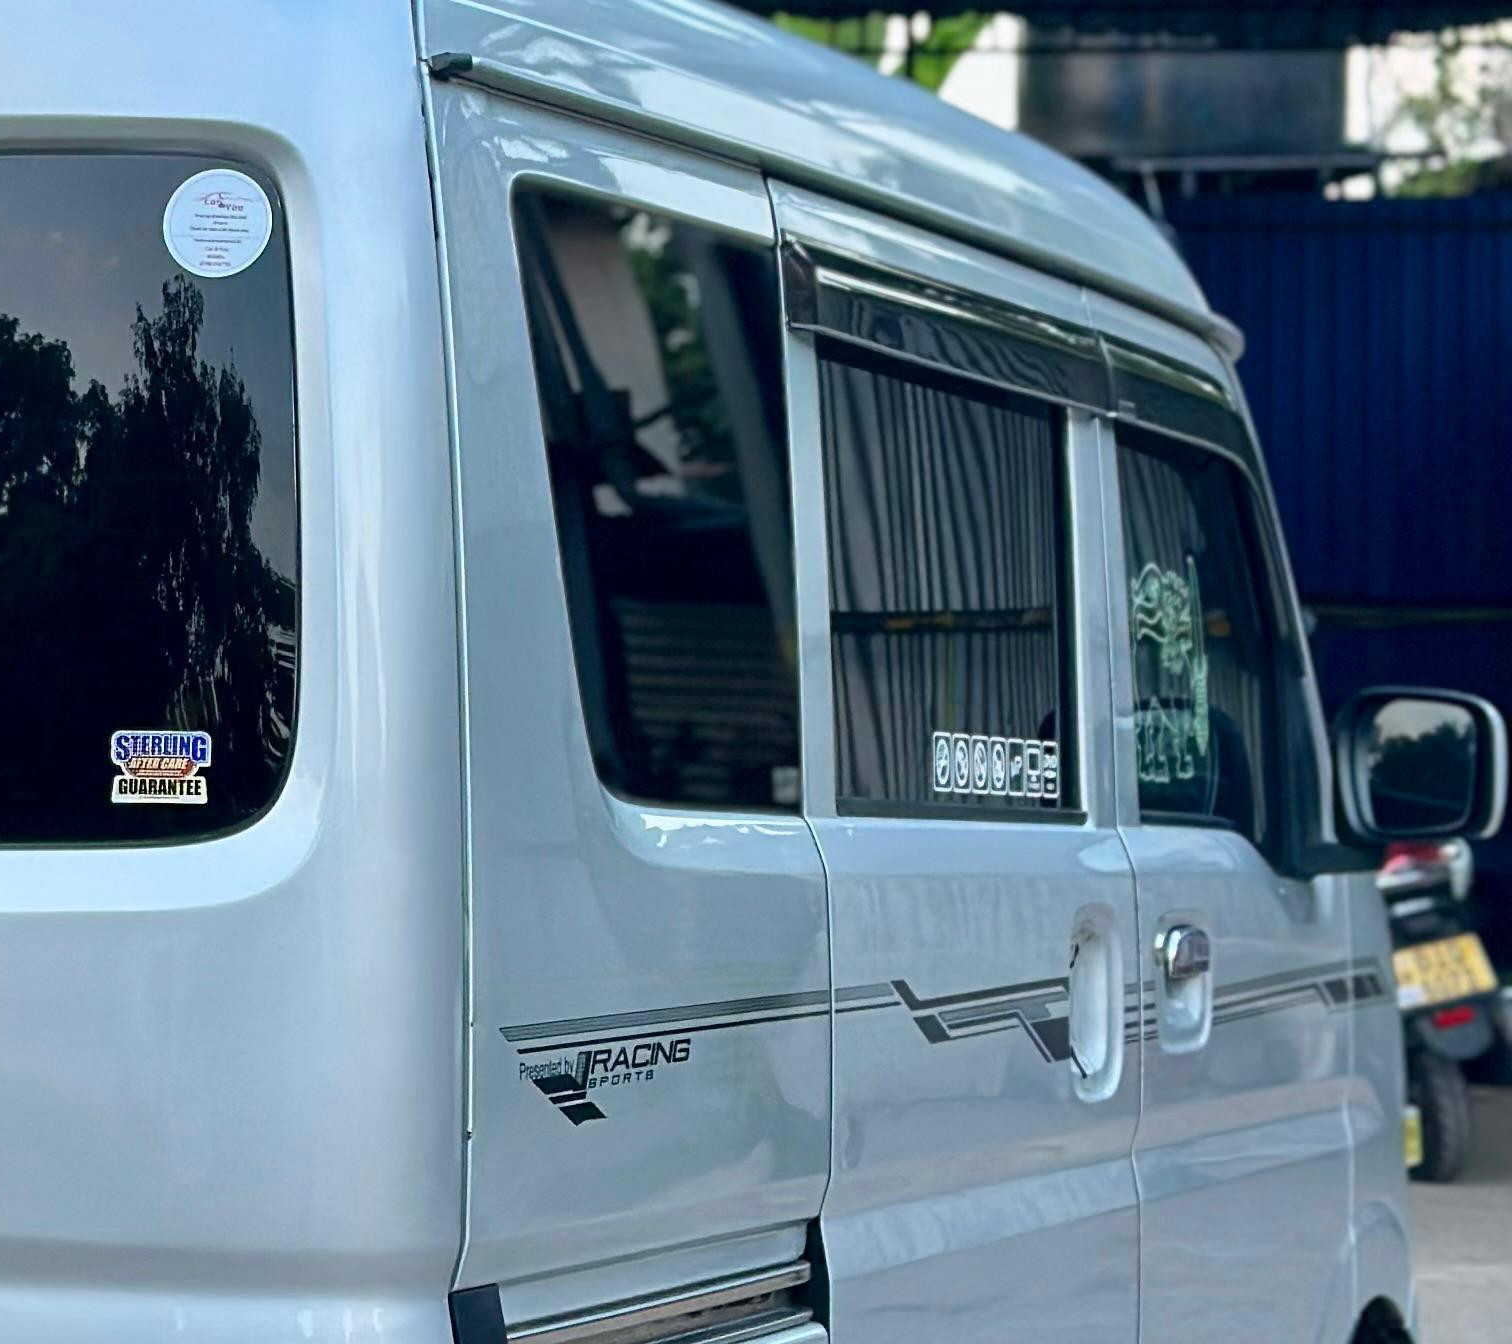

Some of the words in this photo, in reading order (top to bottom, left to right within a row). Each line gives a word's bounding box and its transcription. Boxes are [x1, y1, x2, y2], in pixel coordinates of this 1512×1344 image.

[115, 735, 207, 762] STERLING
[118, 778, 202, 796] GUARANTEE
[590, 1038, 691, 1075] RACING
[588, 1069, 655, 1089] SPORTS
